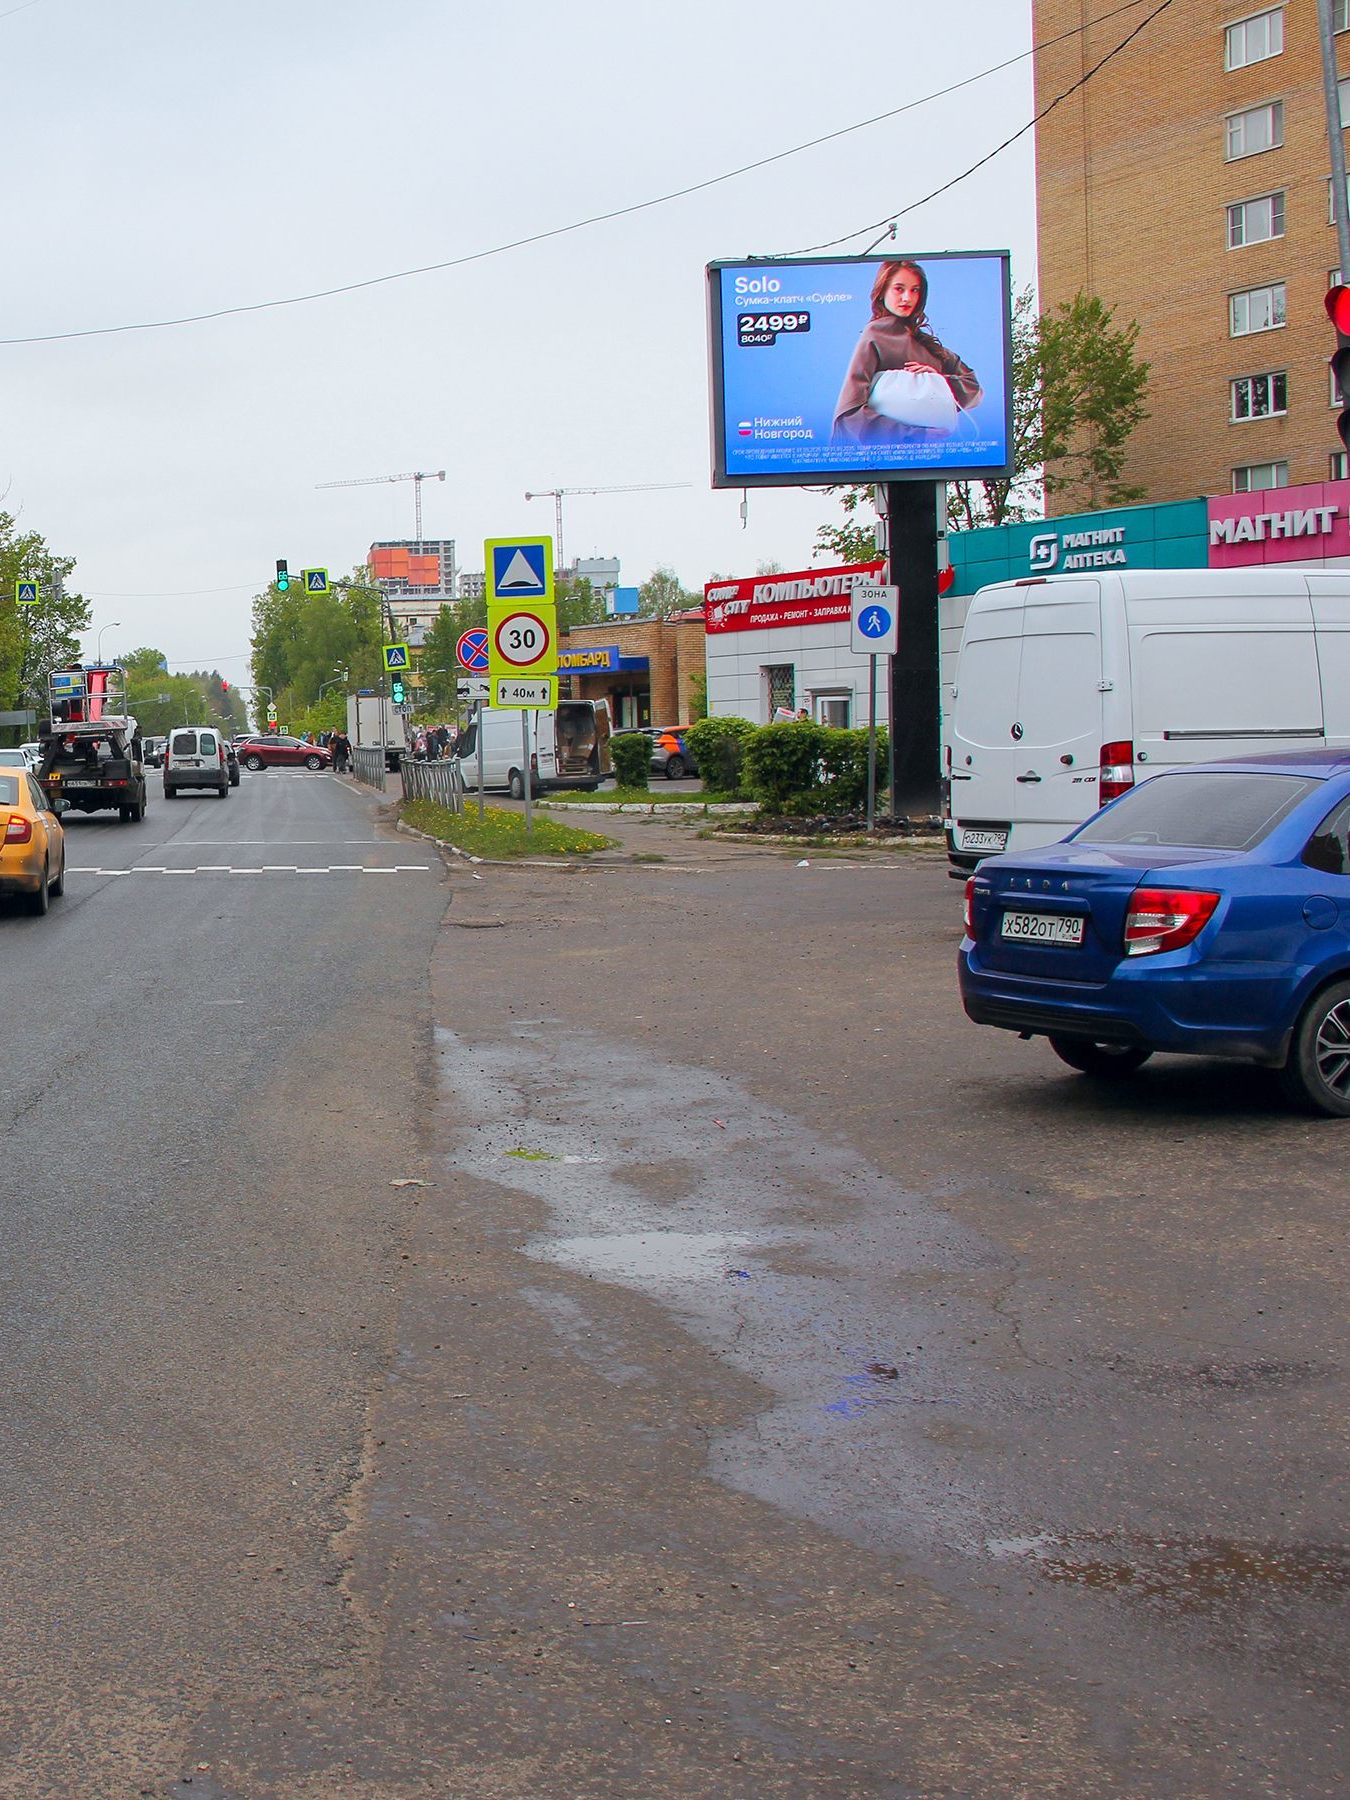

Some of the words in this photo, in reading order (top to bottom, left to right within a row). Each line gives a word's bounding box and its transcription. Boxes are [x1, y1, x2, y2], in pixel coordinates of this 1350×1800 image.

[734, 276, 781, 294] Solo
[734, 295, 803, 308] Сумка-клатч
[805, 293, 853, 305] «Суфле»
[753, 416, 802, 428] Нижний
[753, 429, 813, 441] Новгород
[1209, 505, 1339, 546] МАГНИТ
[1062, 527, 1126, 550] МАГНИТ
[1063, 549, 1127, 570] АПТЕКА
[752, 570, 882, 605] КОМПЬЮТЕРЫ
[861, 590, 888, 599] ЗОНА
[723, 600, 751, 615] CITY
[750, 612, 779, 624] ПРОДАЖА
[783, 609, 809, 621] РЕМОНТ
[813, 606, 847, 617] ЗАПРАВКА
[509, 629, 536, 650] 30
[557, 651, 611, 668] ЛОМБАРД
